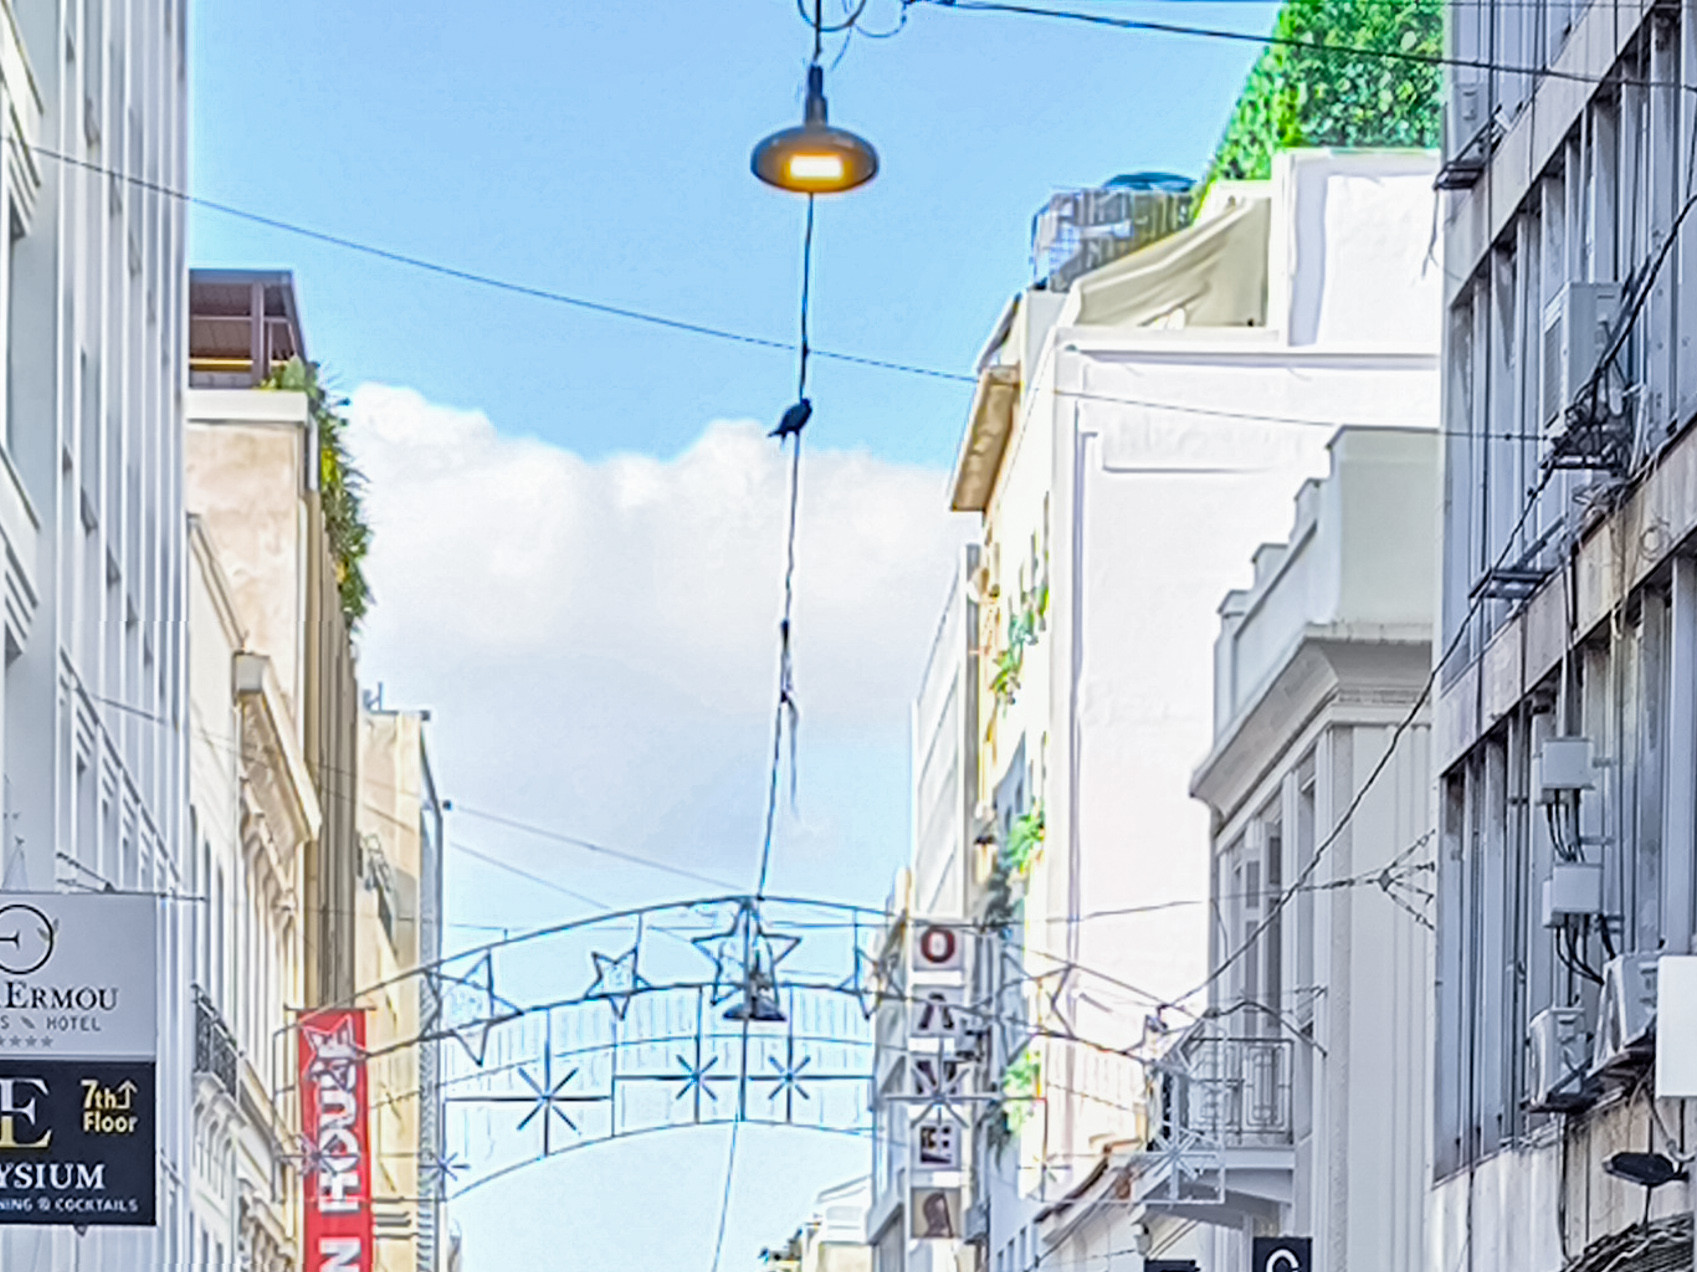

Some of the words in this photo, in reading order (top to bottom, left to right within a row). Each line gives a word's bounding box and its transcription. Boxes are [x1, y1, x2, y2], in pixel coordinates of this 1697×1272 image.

[46, 1014, 102, 1033] HOTEL
[81, 1079, 117, 1110] 7th
[83, 1109, 138, 1135] Floor
[55, 1198, 138, 1213] COCKTAILS
